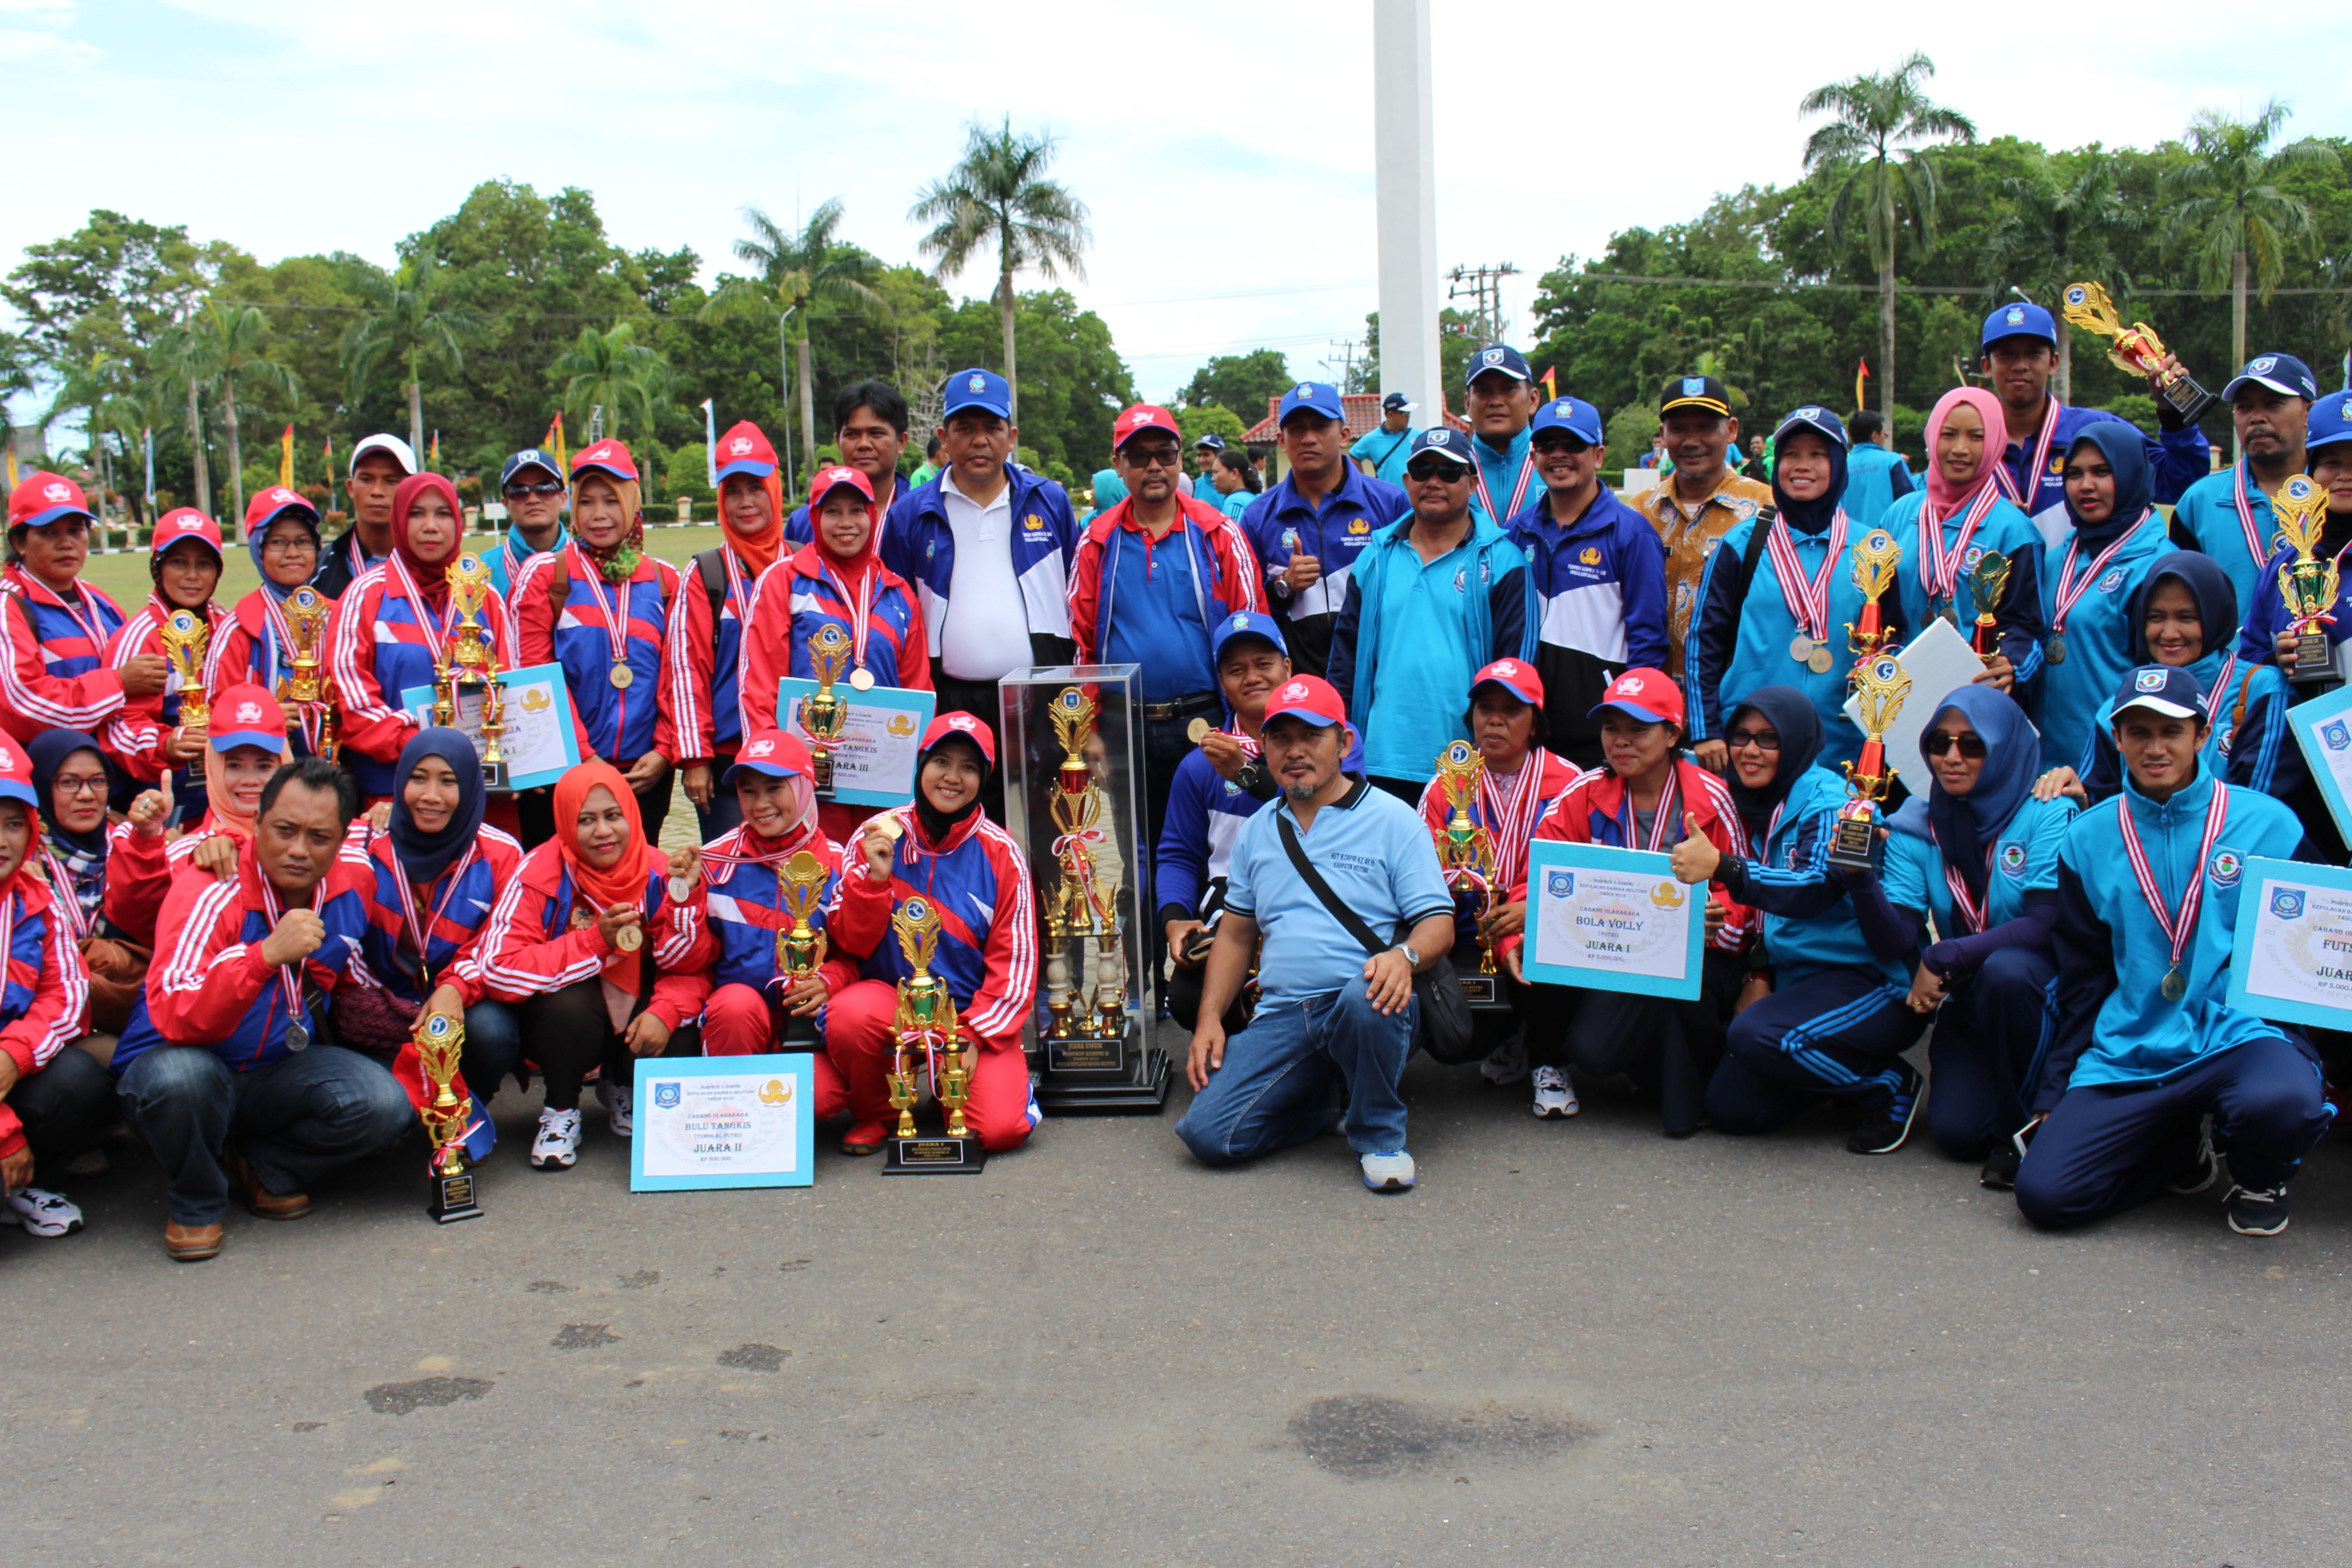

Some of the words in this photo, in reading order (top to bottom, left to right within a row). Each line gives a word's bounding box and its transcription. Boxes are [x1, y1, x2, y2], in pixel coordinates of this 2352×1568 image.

[843, 745, 878, 754] TANGKIS
[835, 762, 858, 771] ARA
[1580, 906, 1604, 914] CABANG
[2312, 904, 2346, 913] KEPULAUAN
[1576, 916, 1605, 927] BOLA
[1608, 919, 1645, 931] VOLLY
[2313, 925, 2343, 935] CABANG
[1585, 940, 1623, 952] JUARA
[1626, 945, 1630, 953] I
[710, 1122, 751, 1130] TANGKIS
[693, 1143, 731, 1153] JUARA
[734, 1143, 742, 1152] II
